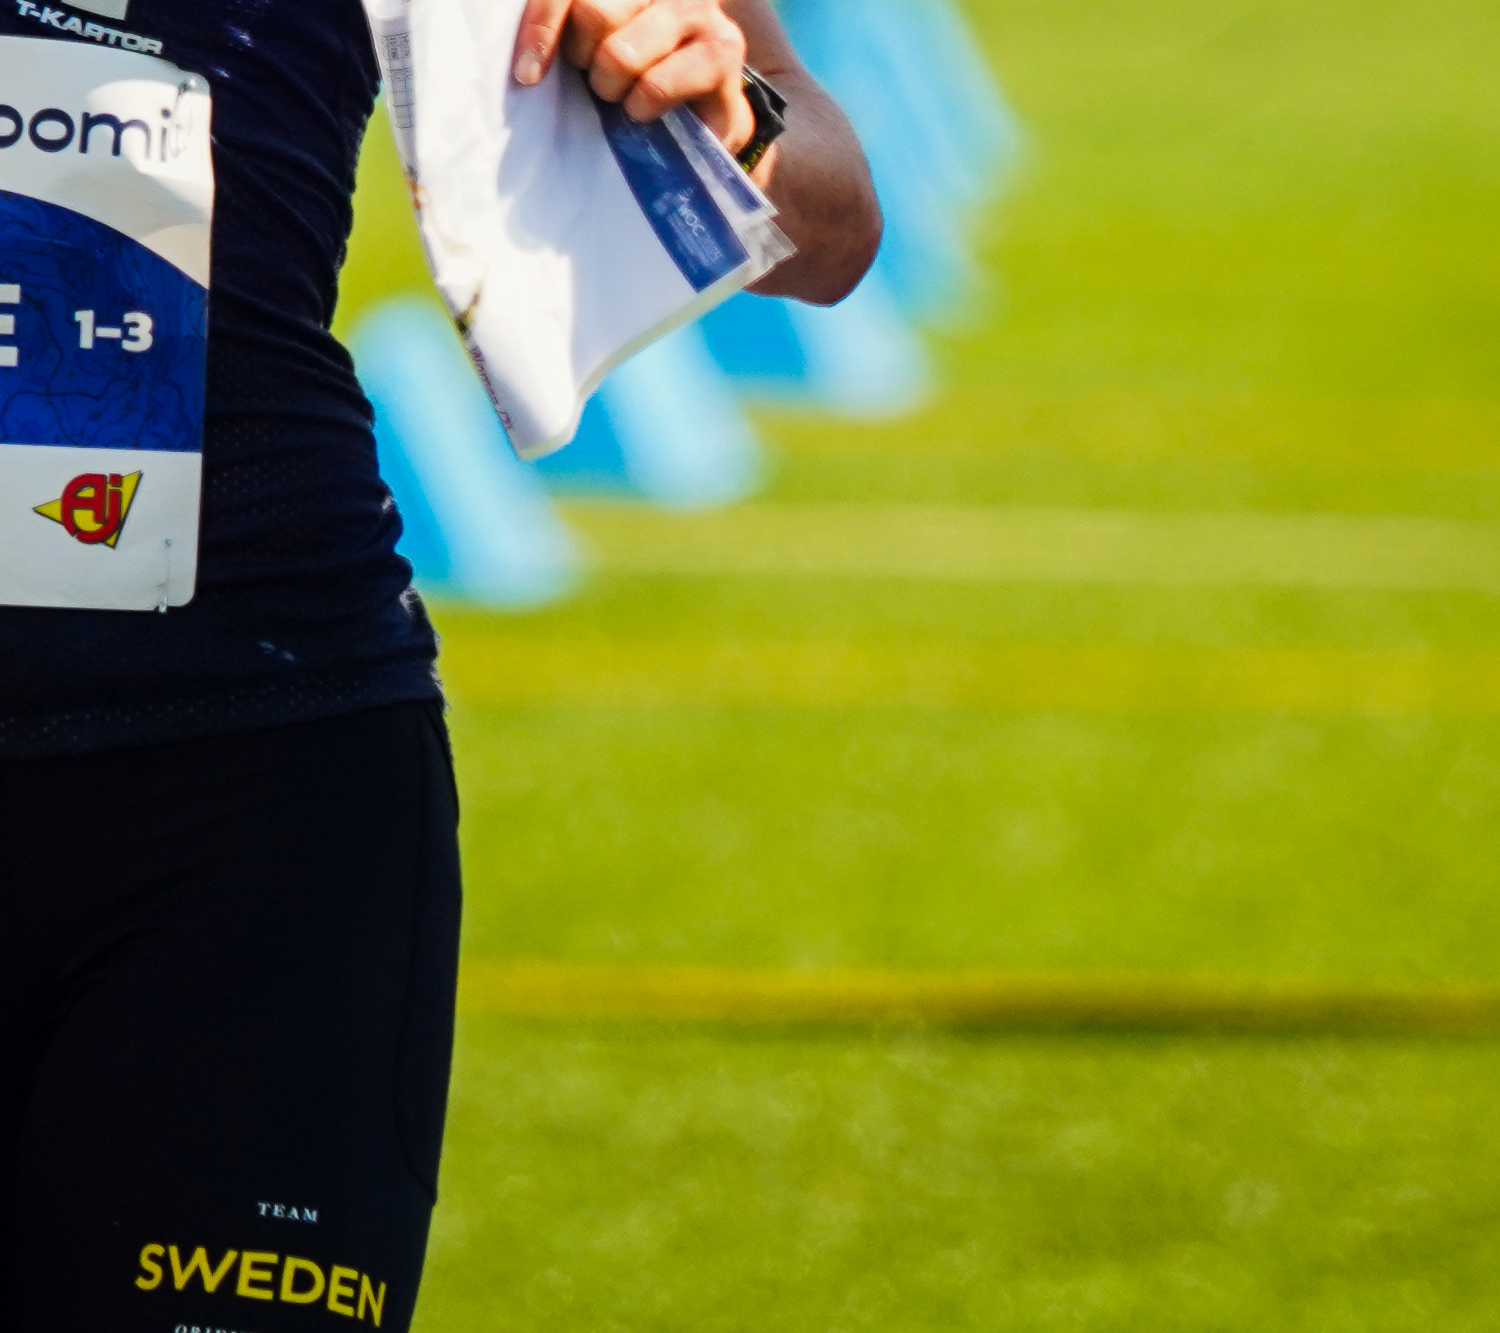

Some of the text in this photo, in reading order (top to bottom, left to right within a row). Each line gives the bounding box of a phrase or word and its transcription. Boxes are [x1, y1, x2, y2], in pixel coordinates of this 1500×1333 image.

[73, 309, 154, 353] 1-3
[256, 1200, 319, 1224] TEAM
[134, 1242, 387, 1328] SWEDEN
